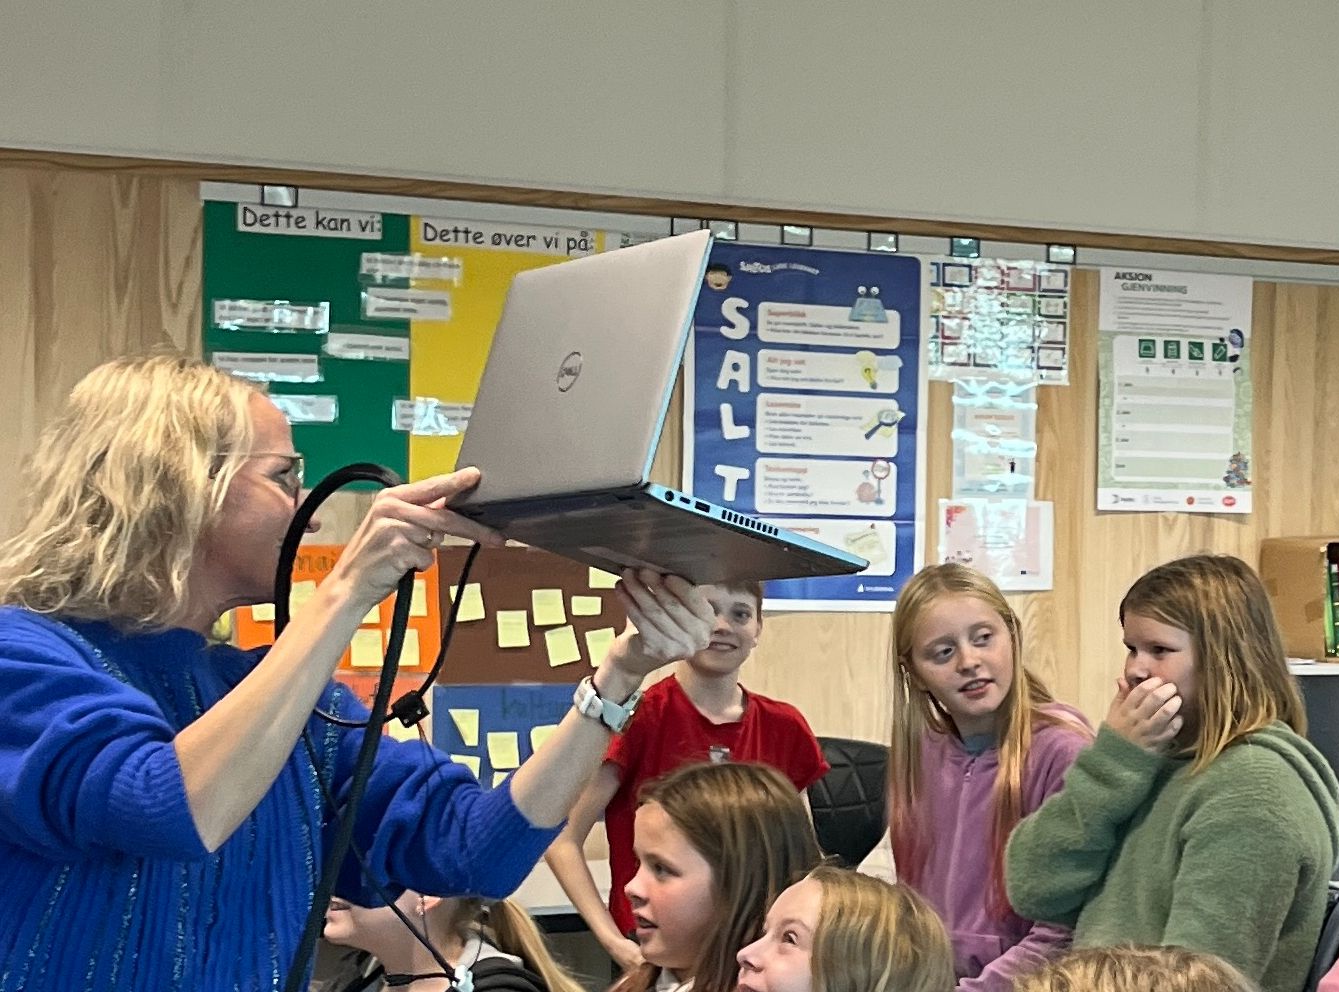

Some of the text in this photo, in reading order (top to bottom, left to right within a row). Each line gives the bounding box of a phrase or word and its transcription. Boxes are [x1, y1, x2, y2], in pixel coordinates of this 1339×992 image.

[242, 206, 382, 233] Dette kan vi:
[423, 222, 485, 245] Dette
[491, 233, 536, 249] øver
[543, 231, 559, 248] vi
[1114, 271, 1152, 281] AKSJON
